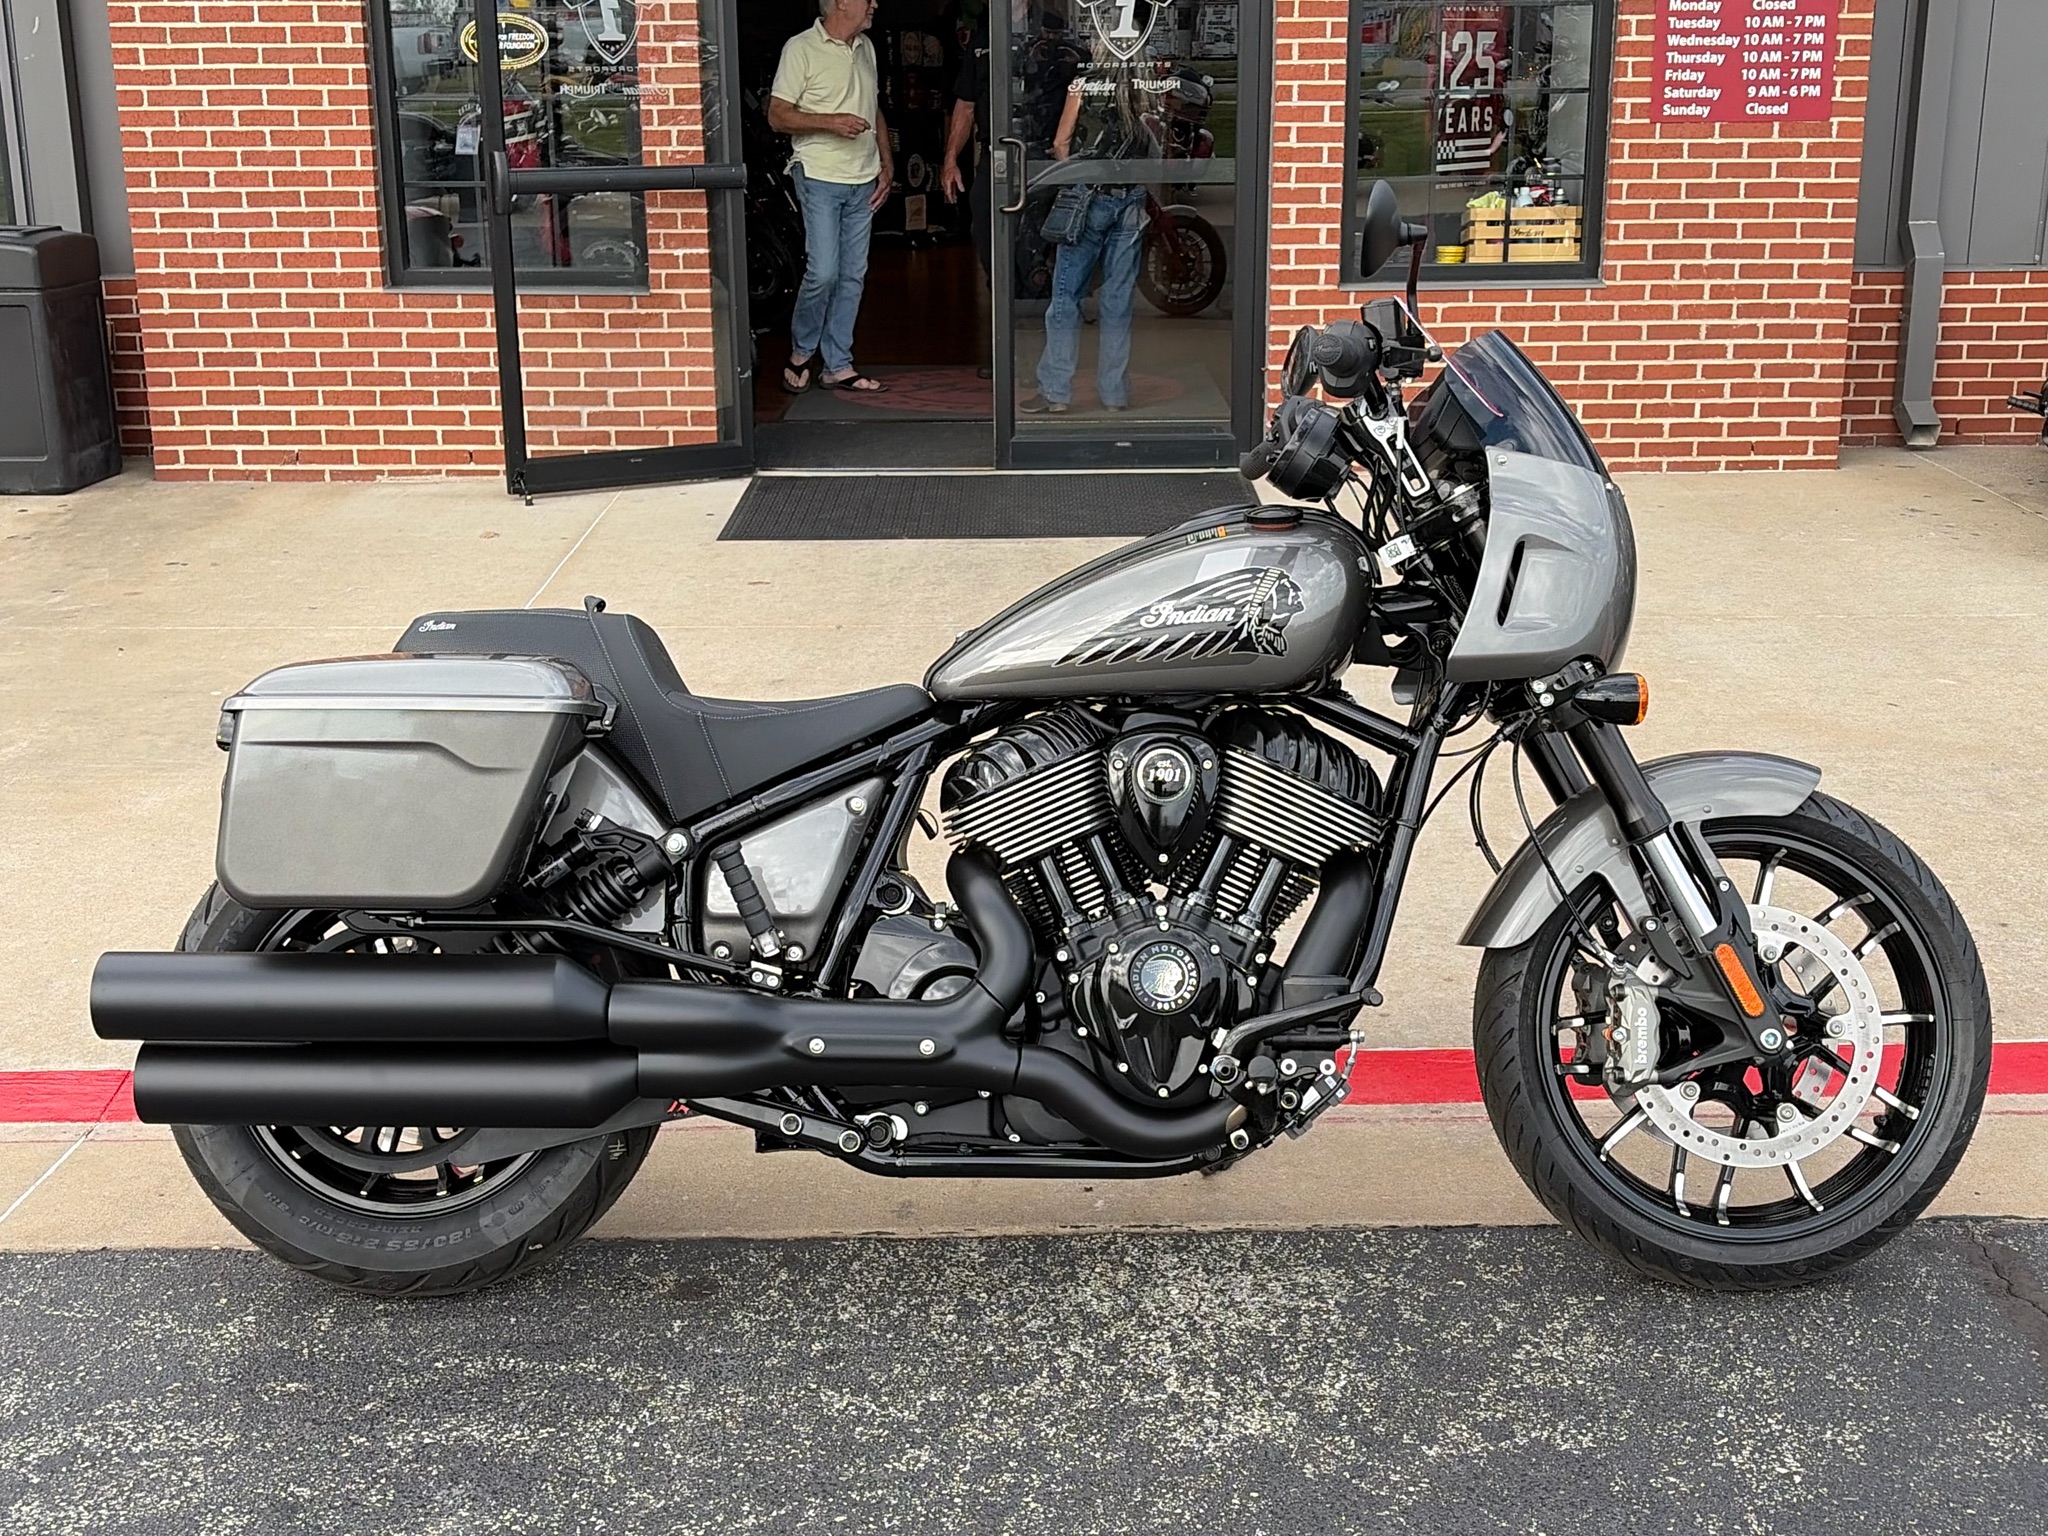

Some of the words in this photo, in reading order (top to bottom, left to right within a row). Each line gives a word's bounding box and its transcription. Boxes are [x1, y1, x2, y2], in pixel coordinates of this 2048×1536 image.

[1669, 0, 1722, 13] Monday
[1752, 0, 1796, 11] Closed
[1668, 16, 1721, 31] Tuesday
[1744, 16, 1760, 28] 10
[1762, 16, 1784, 28] AM
[1794, 16, 1803, 27] 7
[1805, 15, 1826, 27] PM
[1667, 34, 1741, 48] Wednesday
[1743, 34, 1759, 45] 10
[1761, 34, 1783, 45] AM
[1793, 34, 1801, 45] 7
[1803, 33, 1825, 45] PM
[1077, 61, 1172, 69] MOTORSPORTS
[1438, 31, 1497, 98] 125
[1666, 52, 1725, 66] Thursday
[1742, 52, 1758, 63] 10
[1760, 51, 1782, 63] AM
[1792, 51, 1800, 63] 7
[1802, 51, 1823, 62] PM
[1665, 69, 1705, 84] Friday
[1741, 69, 1757, 80] 10
[1758, 69, 1781, 80] AM
[1791, 69, 1799, 80] 7
[1800, 68, 1821, 80] PM
[1067, 77, 1117, 92] Indian
[1131, 79, 1181, 92] TRIUMPH
[1664, 86, 1721, 101] Saturday
[1748, 87, 1756, 98] 9
[1758, 86, 1780, 98] AM
[1789, 86, 1798, 97] 6
[1800, 86, 1821, 97] PM
[1663, 104, 1711, 118] Sunday
[1745, 103, 1788, 115] Closed
[1140, 600, 1236, 628] Indian
[418, 619, 457, 632] Indian
[1147, 768, 1182, 782] 1901
[1133, 953, 1149, 996] INDIAN
[1151, 944, 1198, 1000] MOTORCYCLE
[1634, 1007, 1648, 1064] brembo
